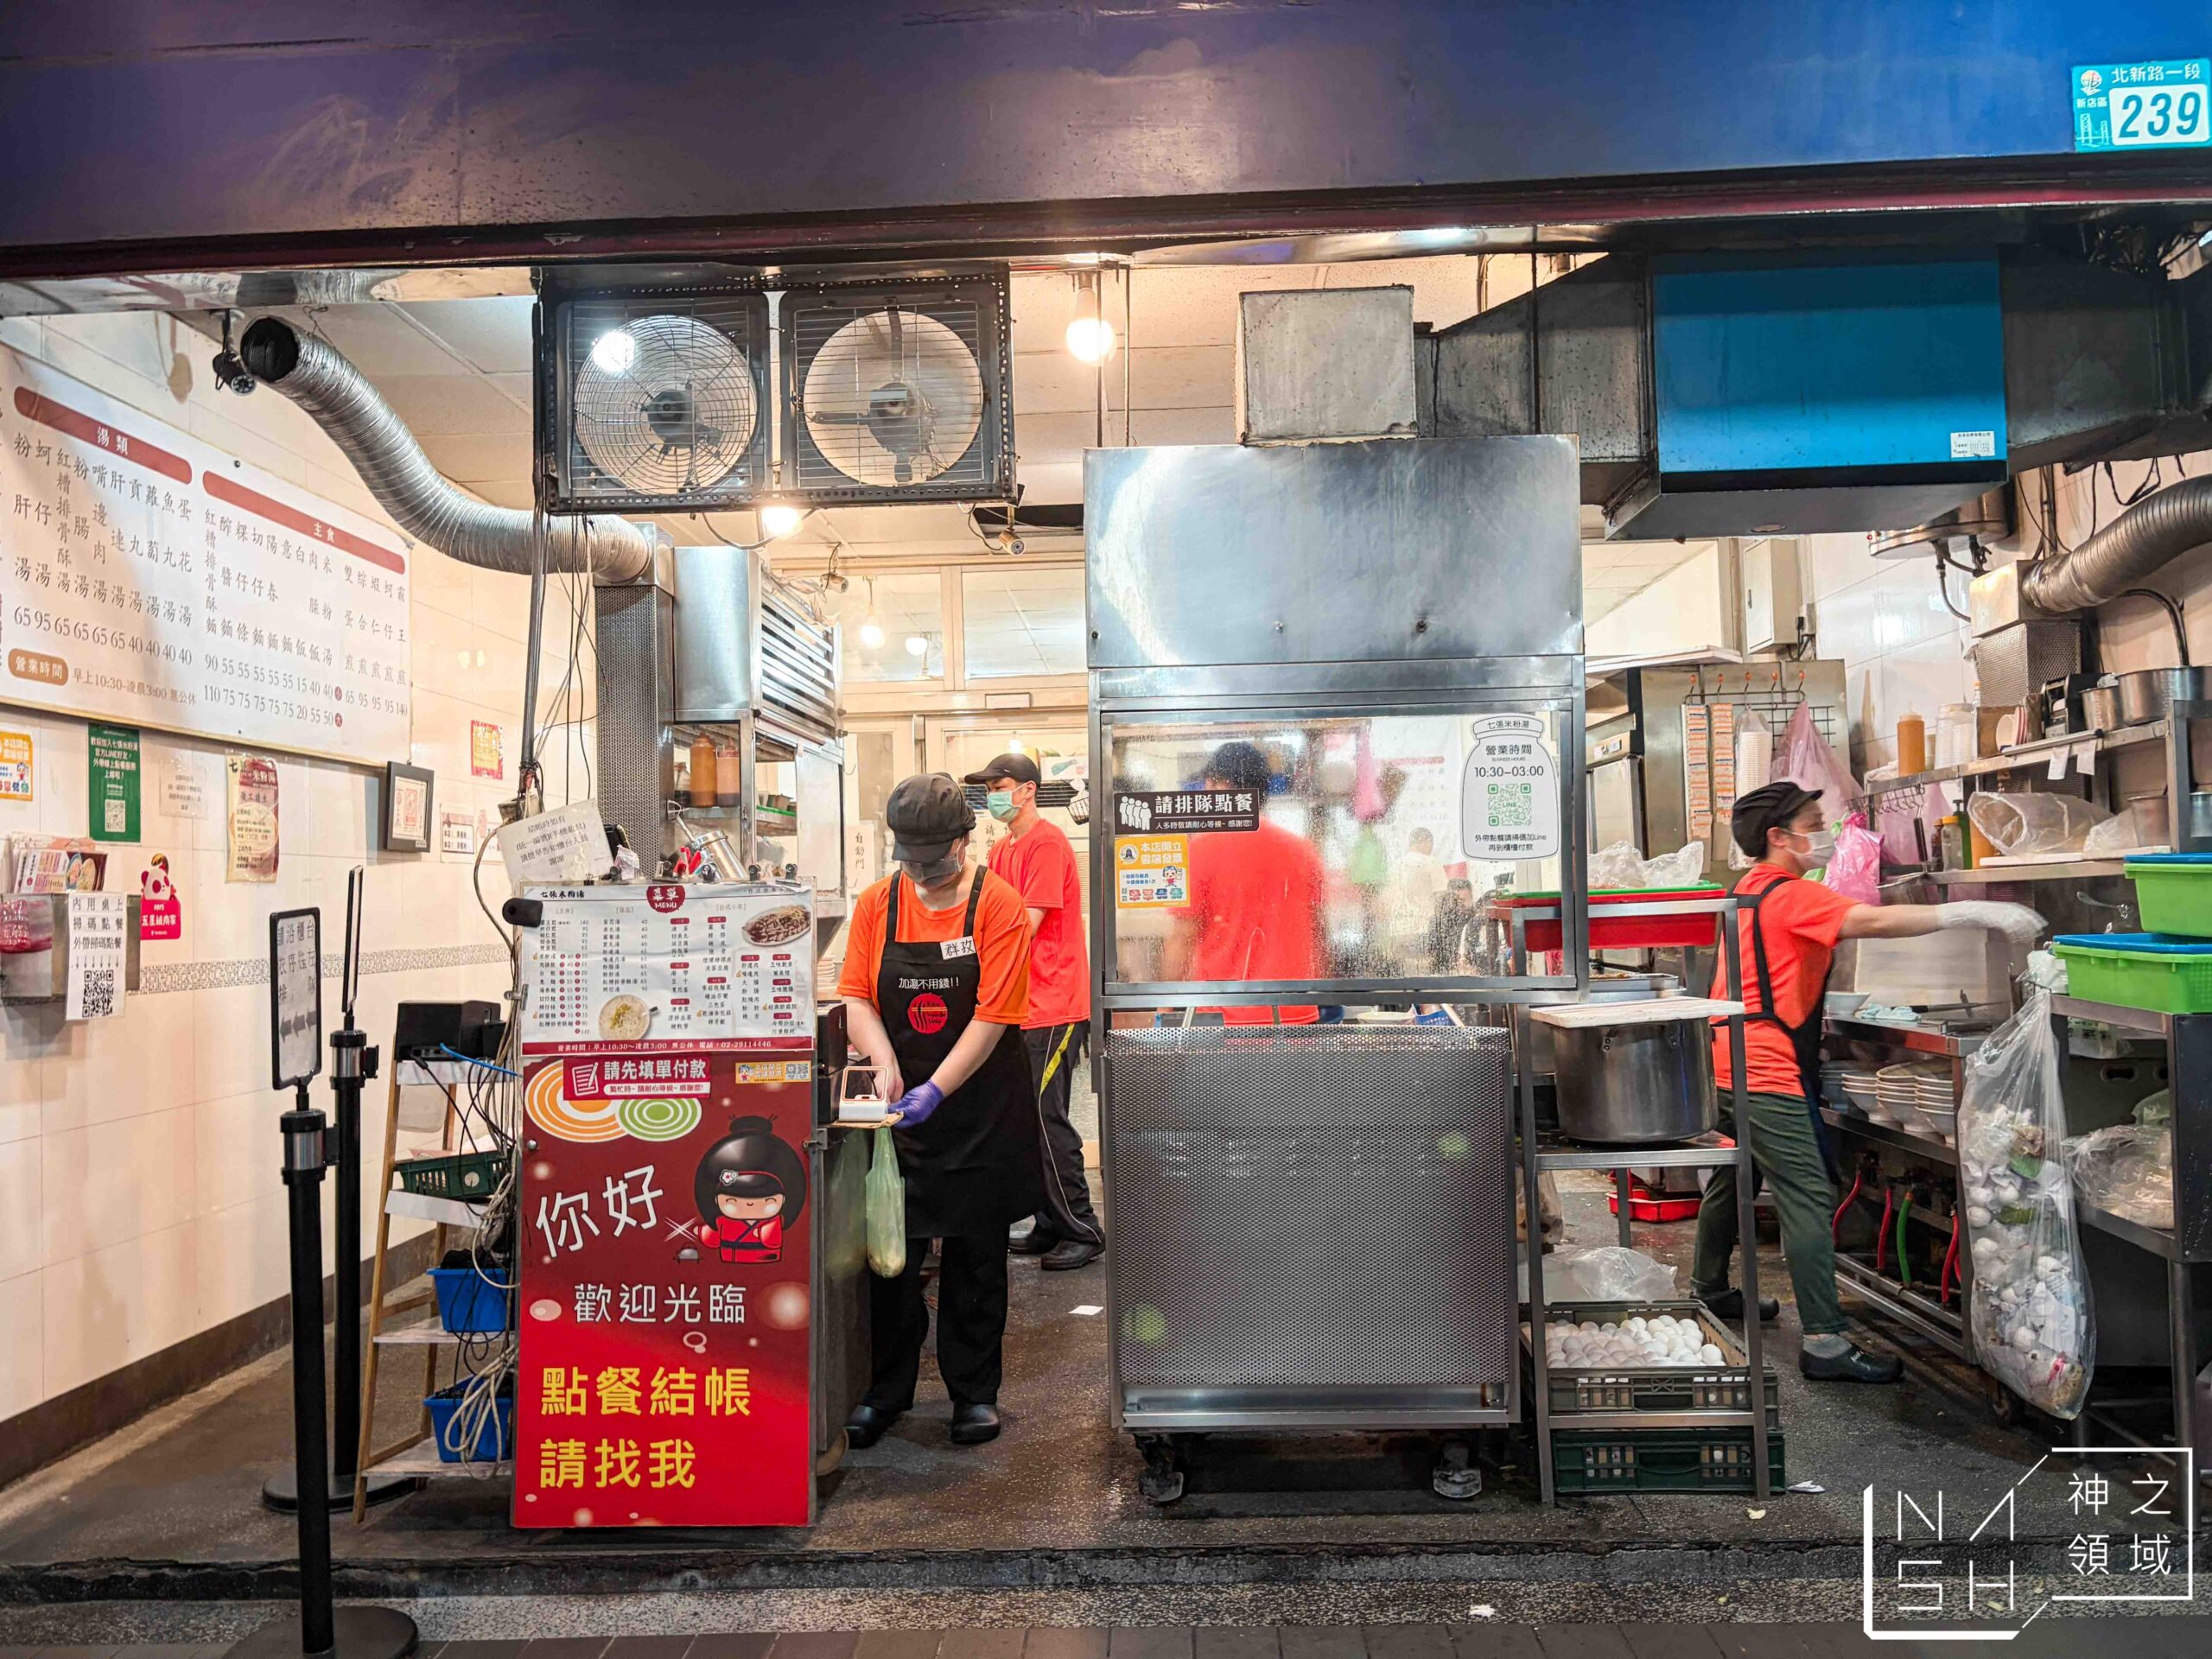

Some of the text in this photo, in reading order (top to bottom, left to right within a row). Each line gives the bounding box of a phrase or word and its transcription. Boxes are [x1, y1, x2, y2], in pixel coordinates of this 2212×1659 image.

[2111, 63, 2201, 83] 北新路一段
[2076, 97, 2107, 109] 新店區
[2119, 92, 2202, 138] 239
[97, 426, 128, 455] 湯類
[314, 522, 335, 543] 主食
[15, 606, 31, 626] 65
[35, 611, 51, 632] 95
[54, 616, 70, 637] 65
[73, 621, 89, 641] 65
[92, 626, 107, 645] 65
[111, 631, 125, 649] 65
[128, 635, 143, 653] 40
[145, 640, 160, 658] 40
[162, 645, 176, 661] 40
[179, 648, 192, 665] 40
[205, 654, 218, 671] 90
[222, 658, 234, 675] 55
[238, 662, 250, 678] 55
[253, 666, 265, 683] 55
[268, 671, 280, 686] 55
[283, 674, 293, 690] 55
[204, 684, 220, 702] 110
[297, 677, 307, 692] 15
[309, 681, 321, 696] 40
[323, 684, 334, 699] 40
[223, 689, 235, 706] 75
[238, 692, 251, 709] 75
[254, 696, 266, 712] 75
[346, 690, 354, 704] 65
[359, 694, 368, 708] 95
[372, 696, 381, 710] 95
[269, 699, 280, 715] 75
[283, 702, 294, 718] 75
[297, 705, 308, 721] 20
[385, 700, 394, 714] 95
[396, 702, 408, 717] 140
[310, 709, 321, 723] 55
[323, 711, 334, 725] 50
[1486, 744, 1532, 755] 營業時間
[1155, 793, 1253, 814] 請排隊點餐
[604, 1058, 707, 1080] 請先填單付款
[535, 1164, 664, 1258] 你好
[574, 1283, 747, 1324] 歡迎光臨
[540, 1367, 751, 1416] 點餐結帳
[540, 1439, 696, 1489] 請找我
